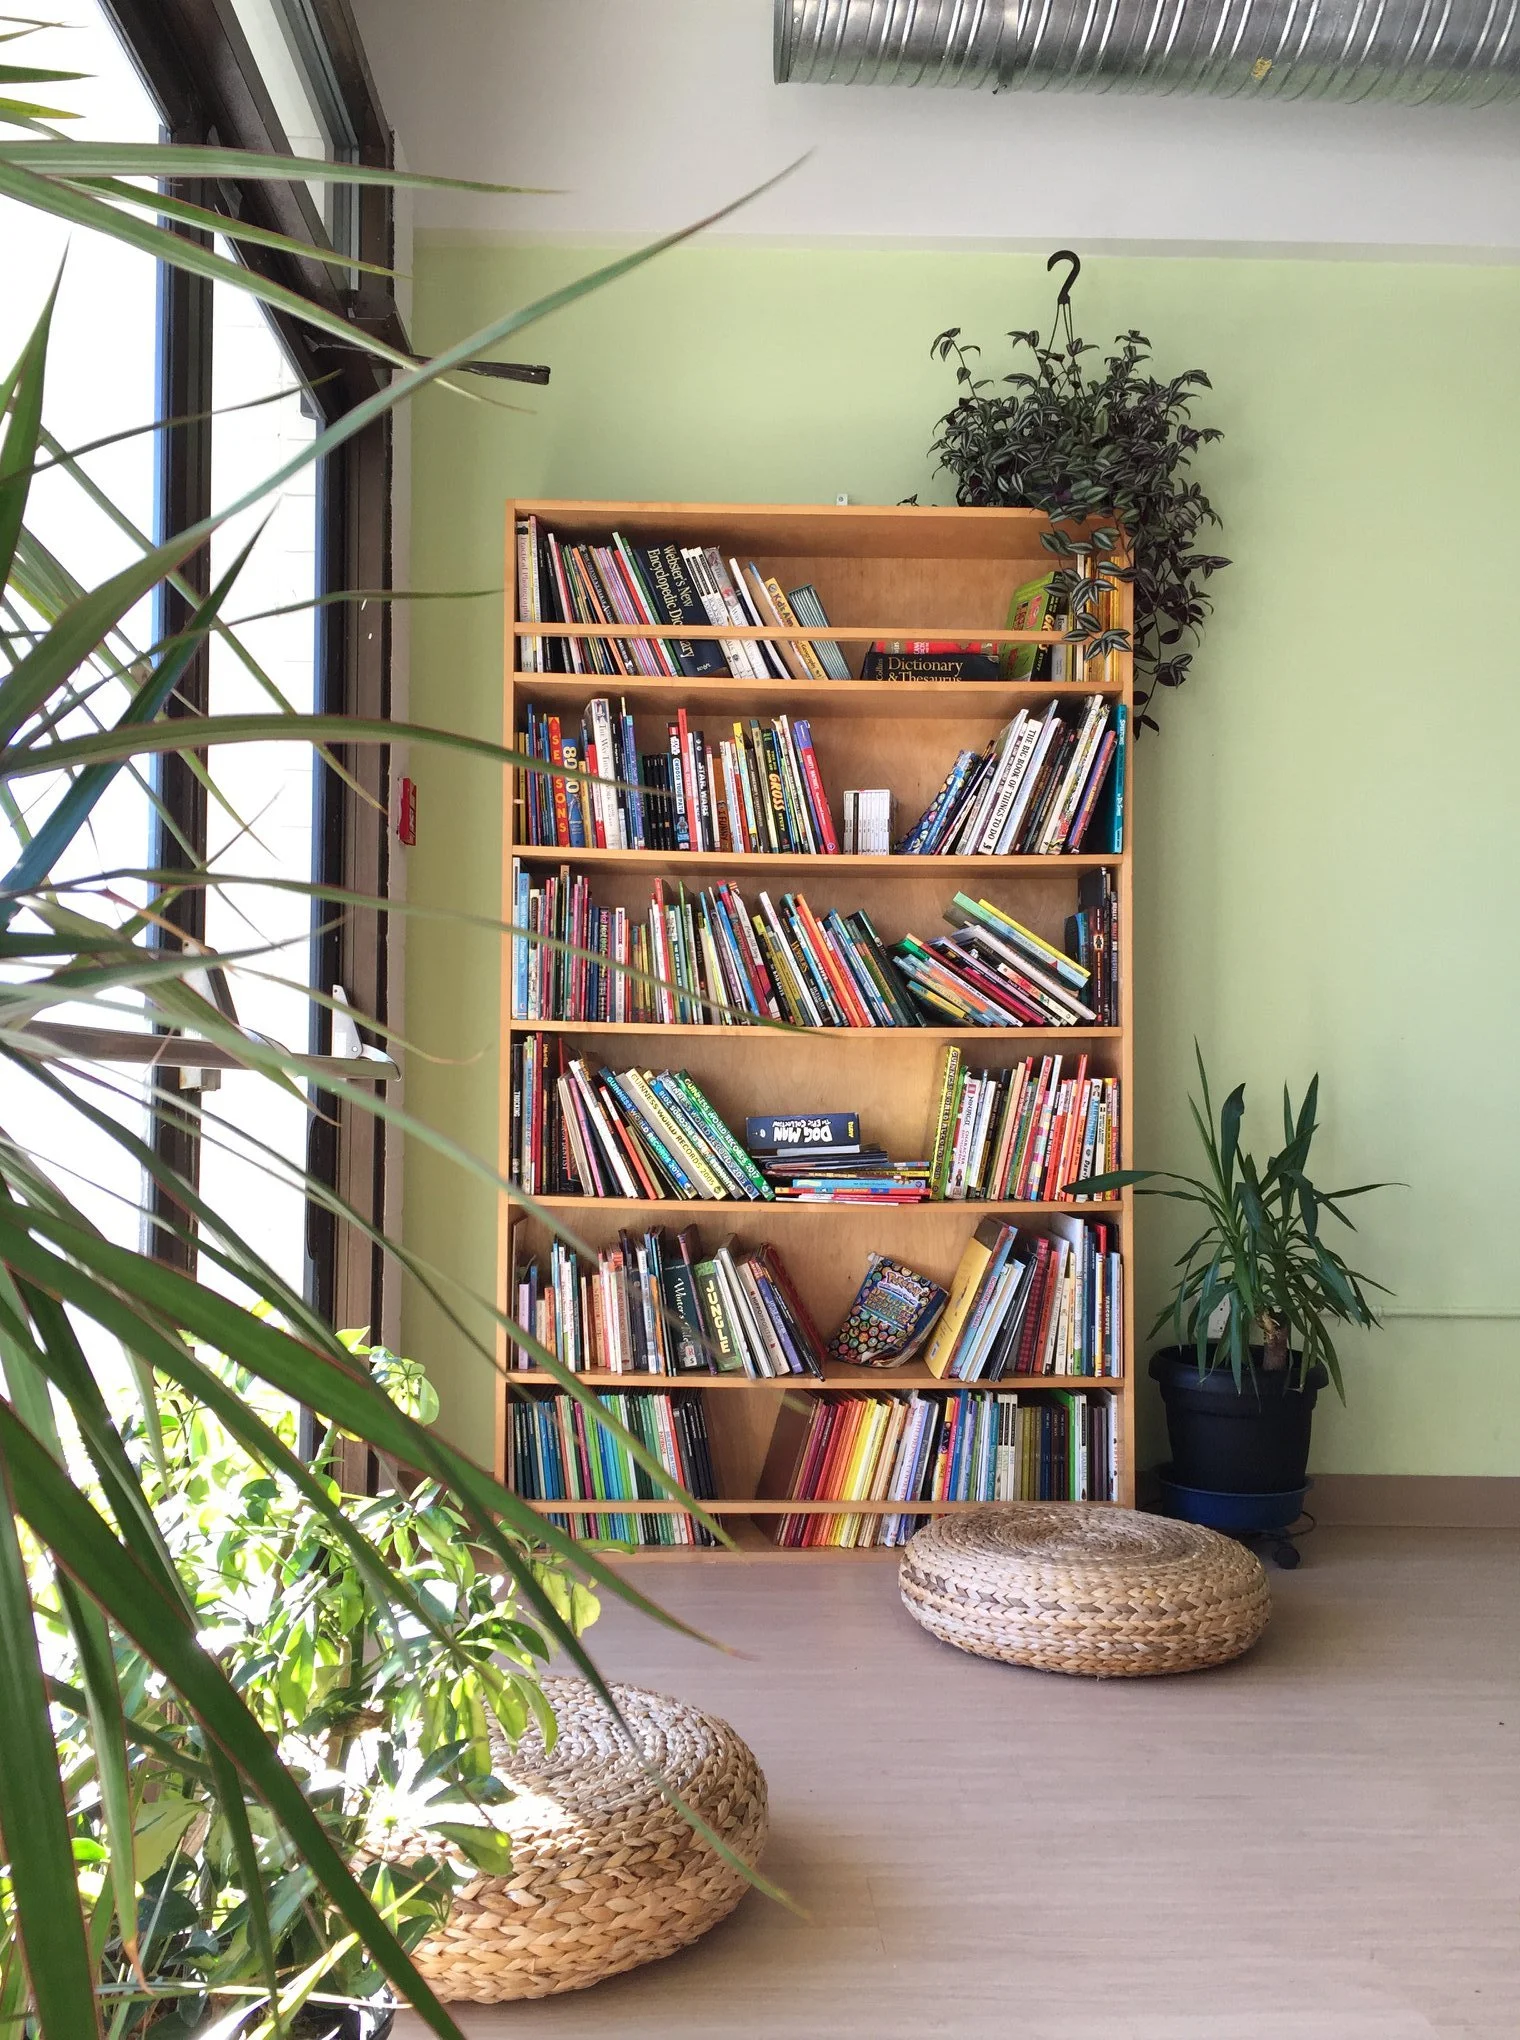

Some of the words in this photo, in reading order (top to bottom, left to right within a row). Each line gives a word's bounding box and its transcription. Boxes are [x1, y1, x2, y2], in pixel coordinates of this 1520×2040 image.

[519, 537, 529, 571] Practical
[664, 544, 687, 587] Webster's
[677, 588, 694, 608] New
[519, 572, 530, 620] Photography
[647, 547, 682, 609] Encyclopedic
[668, 608, 695, 658] Dicary
[888, 657, 964, 678] Dictionary
[888, 671, 900, 684] &
[899, 671, 963, 684] Thesaurus
[1018, 745, 1032, 758] BIG
[1023, 729, 1037, 744] THE
[563, 746, 581, 795] 800
[673, 758, 682, 782] CHOOSE
[697, 762, 708, 789] STAR
[1010, 758, 1026, 778] BOOK
[552, 735, 568, 834] SESONS
[767, 773, 787, 811] GROSS
[1005, 779, 1017, 790] OF
[700, 790, 710, 818] WARS
[995, 791, 1014, 817] THINGS
[718, 816, 730, 842] FUNNY
[987, 829, 998, 841] DO
[990, 818, 1002, 829] TO
[674, 953, 682, 963] CAT
[947, 1050, 959, 1090] GUINNESS
[606, 1076, 635, 1109] GUINNESS
[629, 1109, 652, 1133] WORLD
[645, 1132, 675, 1163] RECORDS
[942, 1090, 953, 1120] WORLD
[962, 1095, 977, 1127] NINJAGO
[631, 1073, 657, 1110] GUINNESS
[656, 1110, 679, 1136] WORLD
[675, 1135, 704, 1168] RECORDS
[699, 1169, 715, 1186] 2005
[664, 1076, 695, 1111] GUINNESS
[687, 1112, 711, 1135] WORLD
[707, 1135, 735, 1168] RECORDS
[671, 1107, 700, 1136] RECORDS
[683, 1077, 712, 1111] GUINNESS
[703, 1111, 728, 1134] WORLD
[721, 1134, 750, 1163] RECORDS
[743, 1162, 761, 1180] 2017
[773, 1126, 803, 1143] MAN
[803, 1124, 833, 1143] DOG
[937, 1122, 949, 1161] RECORDS
[960, 1129, 971, 1165] CHARACTER
[708, 1158, 737, 1191] GUINNESS
[673, 1277, 691, 1319] Winter's
[705, 1279, 732, 1354] JUNGLE
[1103, 1295, 1112, 1335] VANCOUVER
[659, 1430, 668, 1456] PATIENCE
[900, 1463, 913, 1501] COOKBO
